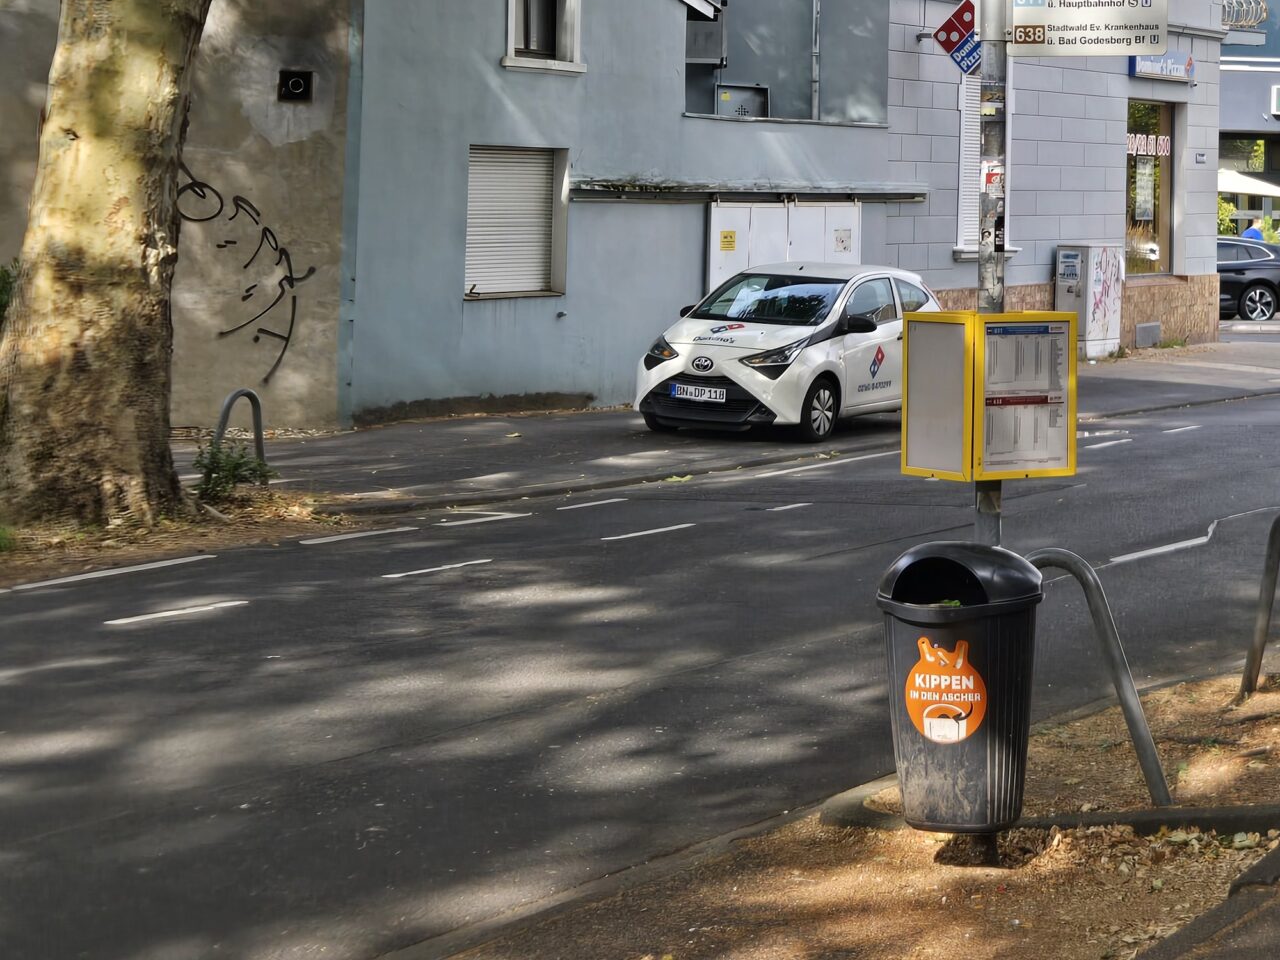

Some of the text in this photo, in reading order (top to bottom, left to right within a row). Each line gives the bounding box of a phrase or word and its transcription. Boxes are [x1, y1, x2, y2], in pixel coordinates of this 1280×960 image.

[1047, 1, 1056, 9] ü.
[1047, 23, 1160, 32] Stadtwald Ev. Krankenhaus
[1015, 27, 1044, 42] 638
[1047, 37, 1055, 45] ü.
[1058, 36, 1077, 45] Bad
[1079, 36, 1132, 47] Godesberg
[1134, 35, 1146, 44] Bf
[676, 385, 689, 397] BN
[694, 387, 706, 398] DP
[915, 673, 974, 690] KIPPEN
[910, 690, 981, 702] IN DEN ASCHER
